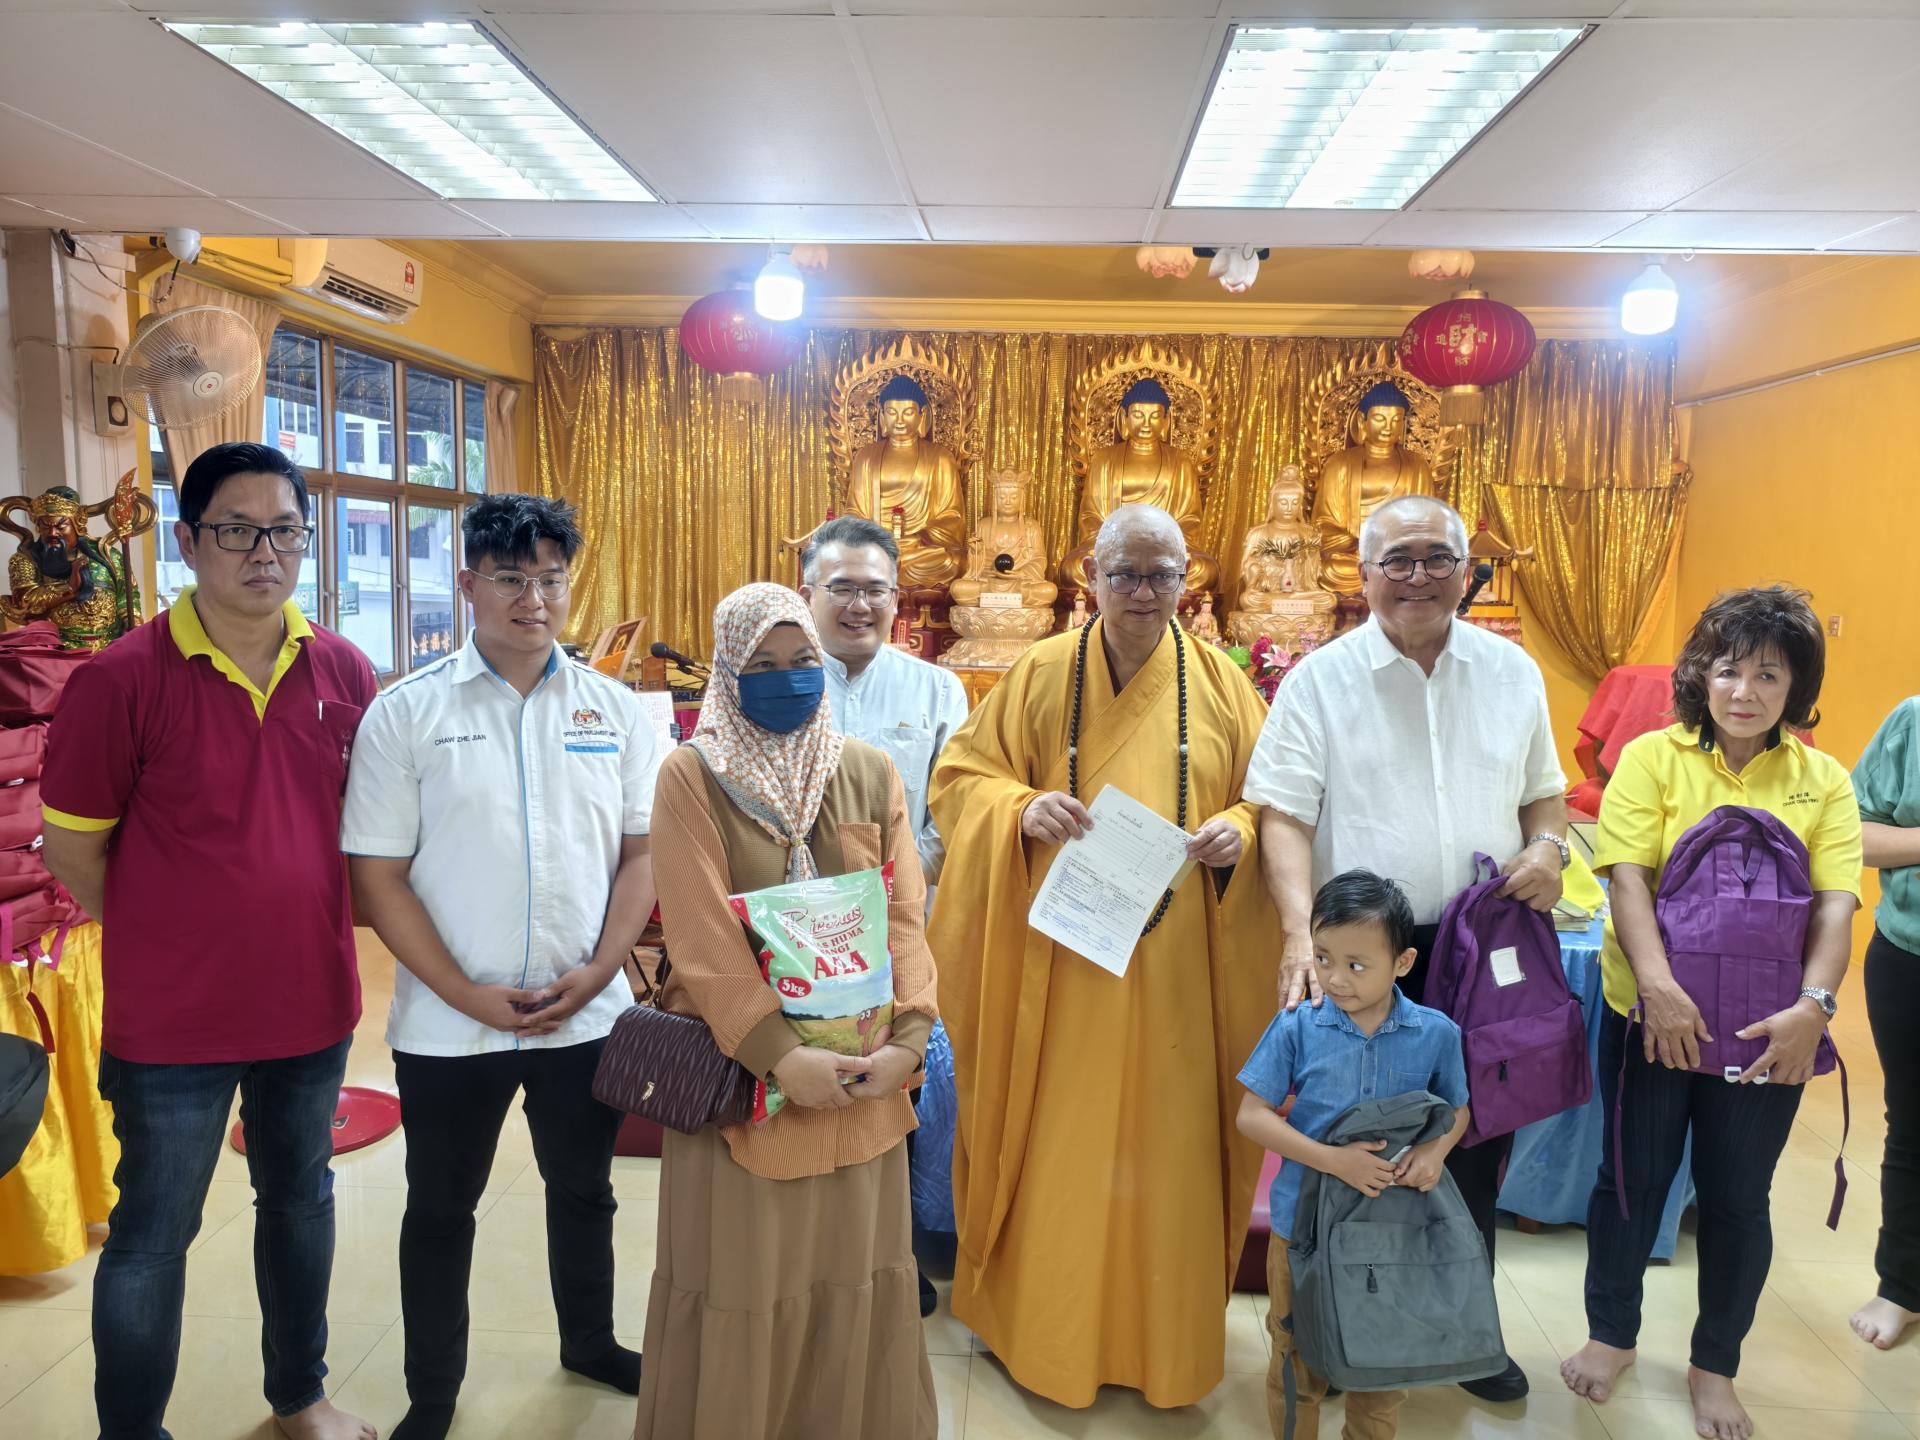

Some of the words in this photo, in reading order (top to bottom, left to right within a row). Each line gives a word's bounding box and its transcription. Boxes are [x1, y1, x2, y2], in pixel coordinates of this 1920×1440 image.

[434, 736, 455, 746] CHAW
[456, 735, 471, 743] ZHE
[831, 927, 864, 947] HUMA
[813, 950, 870, 980] AAA
[782, 979, 806, 997] 5kg
